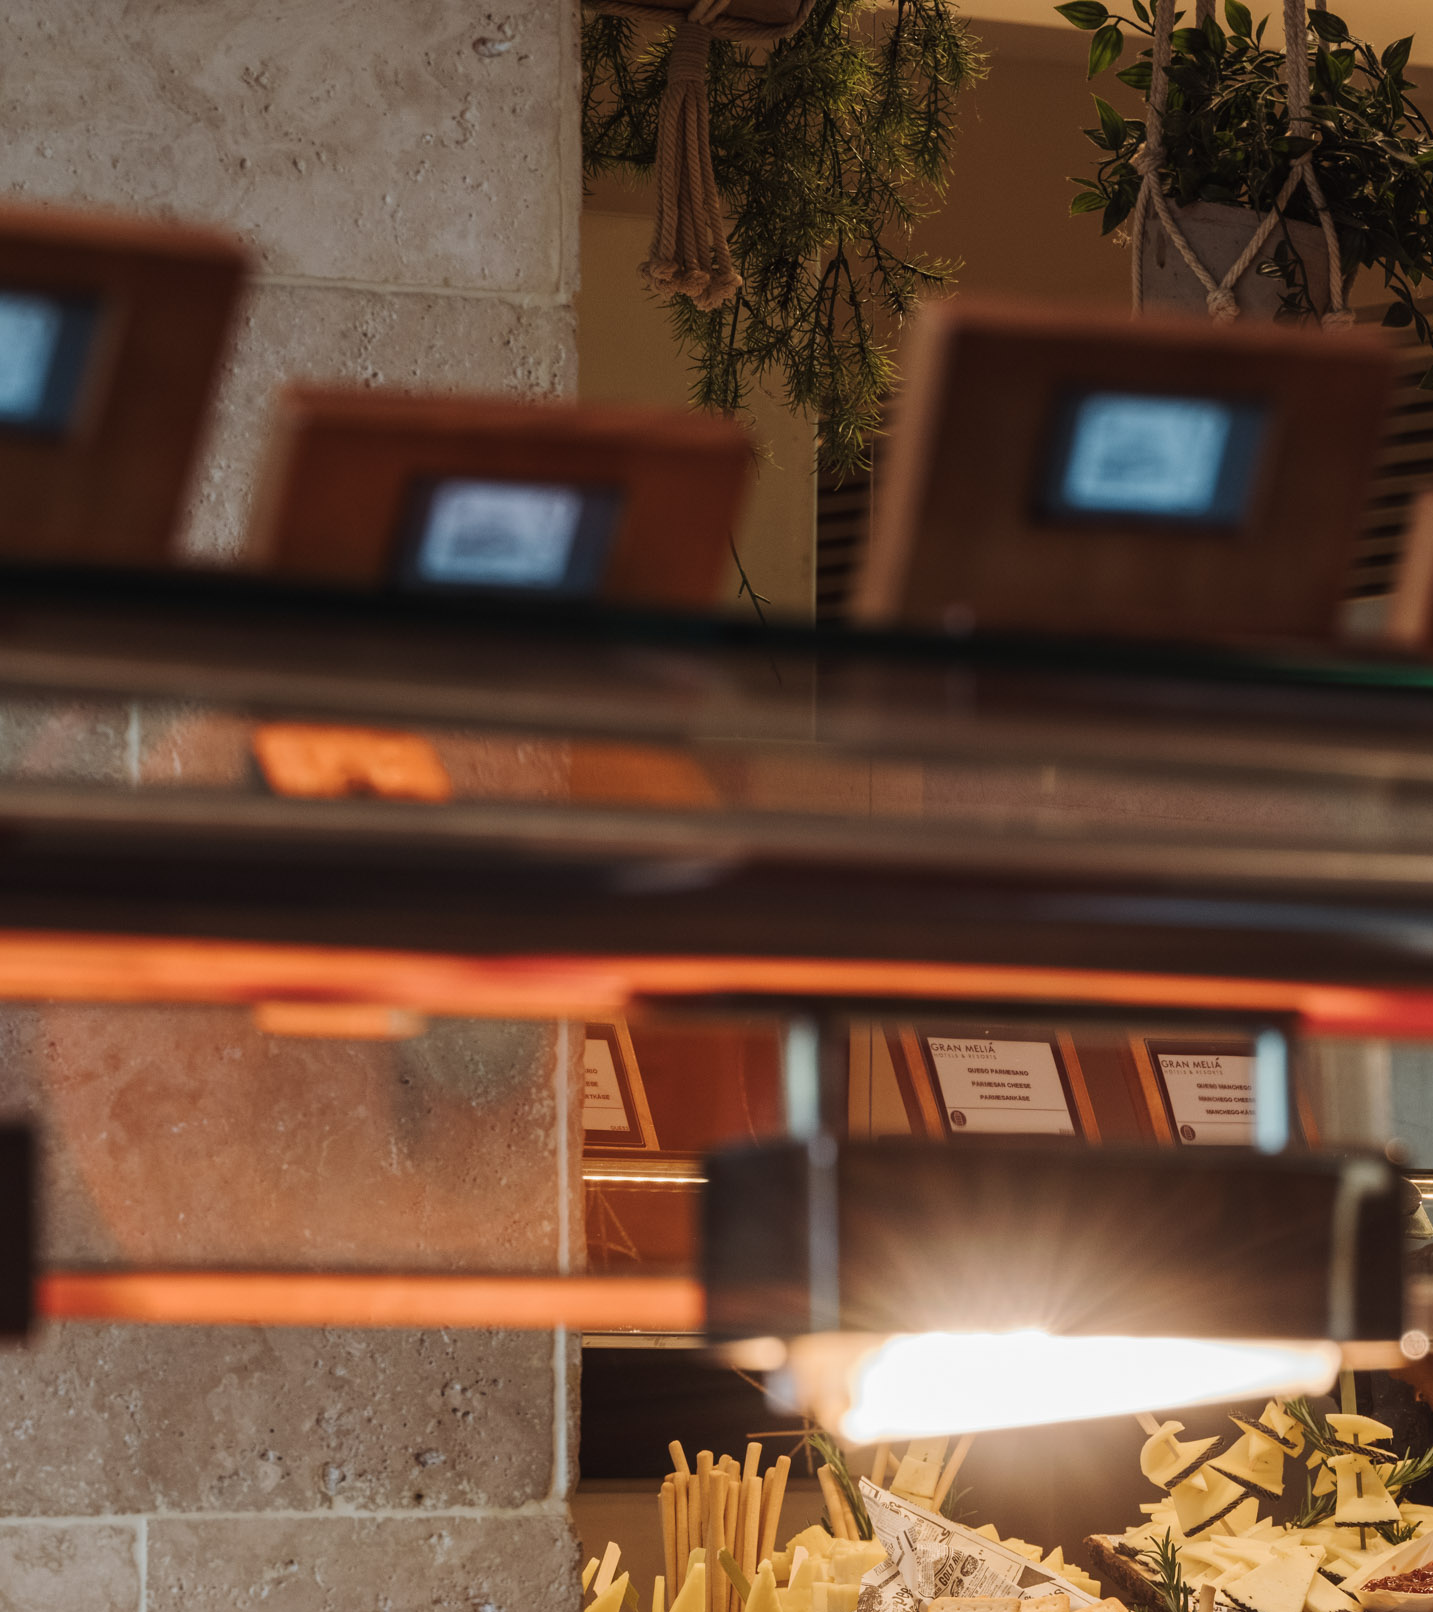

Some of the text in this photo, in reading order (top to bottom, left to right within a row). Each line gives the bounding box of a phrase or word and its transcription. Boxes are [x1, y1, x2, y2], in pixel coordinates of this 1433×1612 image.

[930, 1042, 996, 1054] GRAN MELIÁ
[1161, 1057, 1222, 1069] GRAN MELIÁ
[990, 1068, 1029, 1076] PARMESANO
[938, 1566, 955, 1586] GOLD
